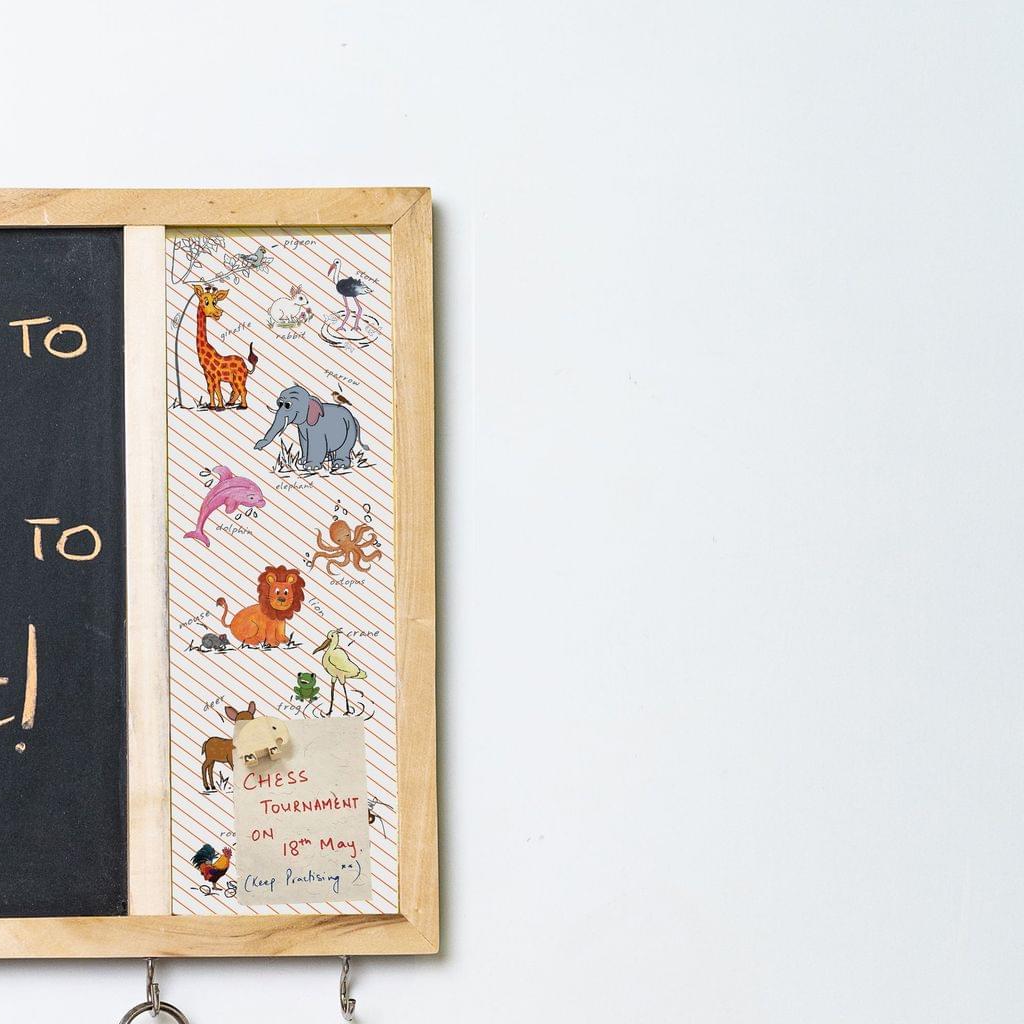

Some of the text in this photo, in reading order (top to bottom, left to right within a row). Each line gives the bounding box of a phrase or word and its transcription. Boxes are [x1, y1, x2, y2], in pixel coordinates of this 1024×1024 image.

[284, 239, 317, 249] pigeon
[9, 316, 88, 359] TO
[275, 331, 306, 340] rabbit
[324, 369, 361, 386] sparrow
[275, 481, 315, 493] elephant
[216, 523, 254, 536] dolphin
[24, 517, 103, 562] TO
[329, 577, 366, 588] octopus
[308, 597, 325, 616] lion
[179, 610, 211, 630] mouse
[277, 702, 302, 716] frog
[243, 770, 309, 790] CHESS
[260, 797, 359, 815] TOURNAMENT
[251, 828, 274, 842] ON
[282, 837, 312, 857] 18th
